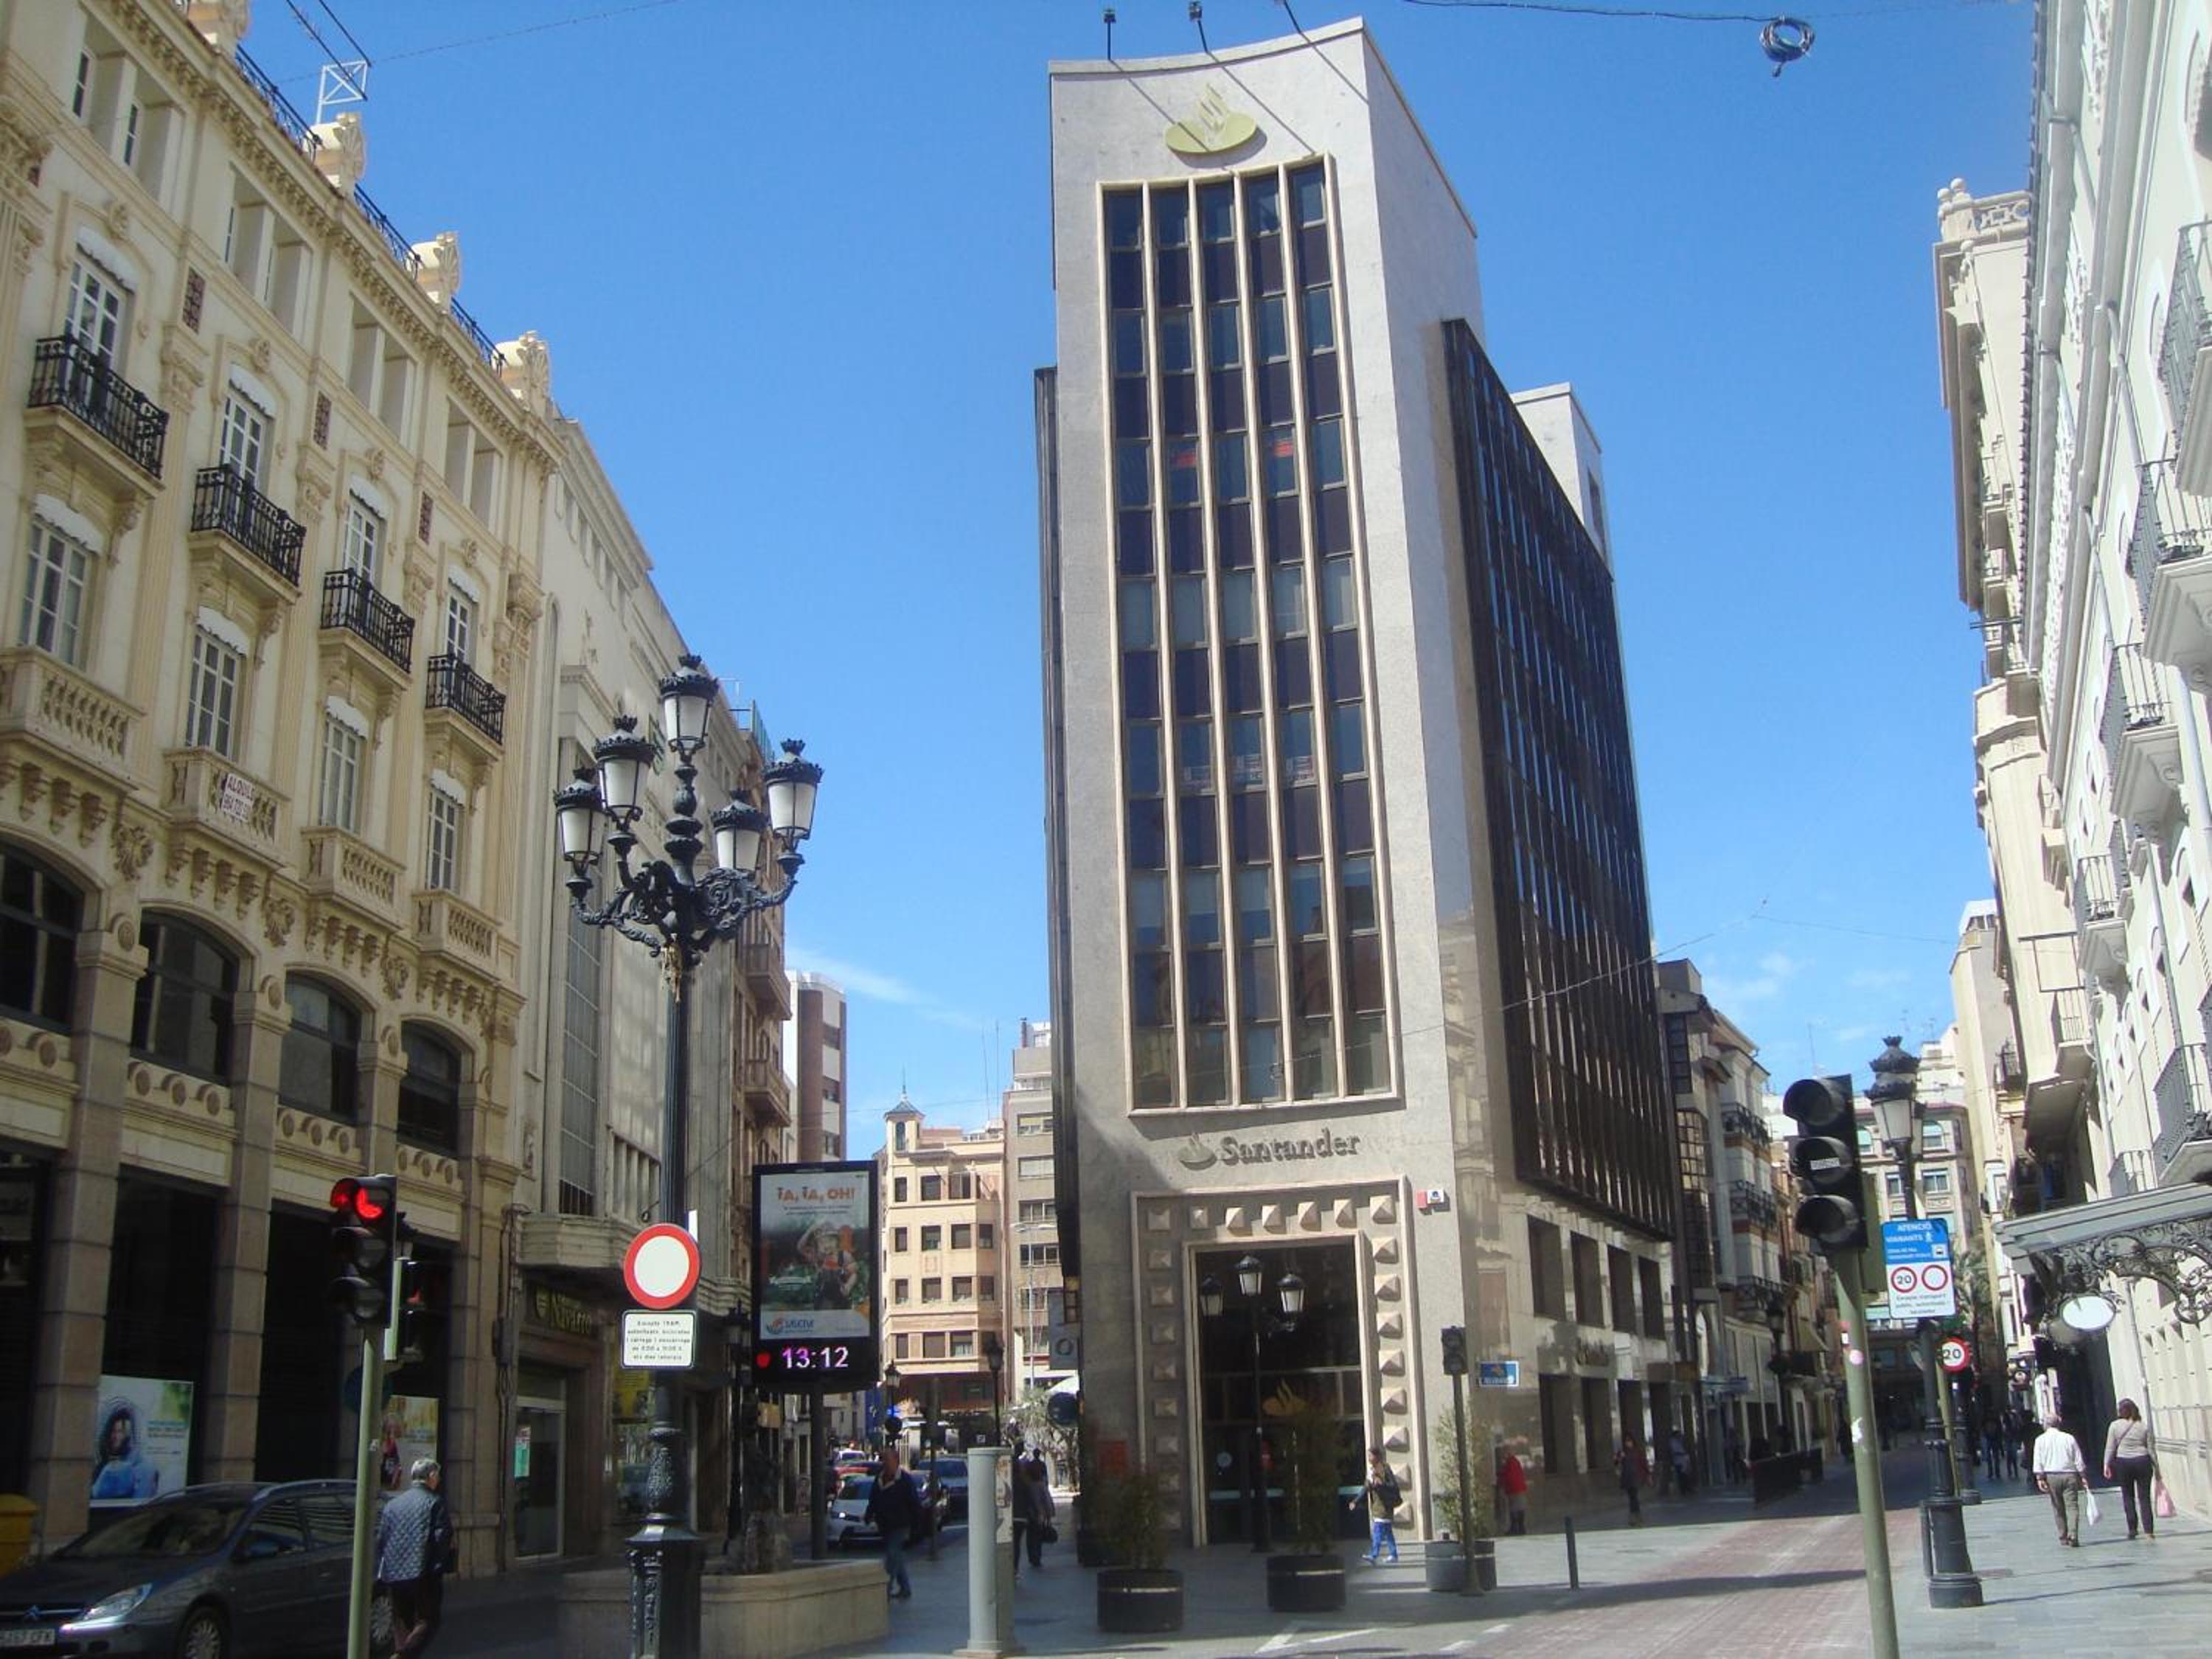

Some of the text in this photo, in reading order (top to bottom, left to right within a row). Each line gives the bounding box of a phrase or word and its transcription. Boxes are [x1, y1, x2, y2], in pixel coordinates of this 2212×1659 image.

[1217, 1127, 1360, 1166] Santander
[1896, 1275, 1912, 1285] 20
[782, 1346, 849, 1369] 13:12
[1942, 1349, 1962, 1360] 20
